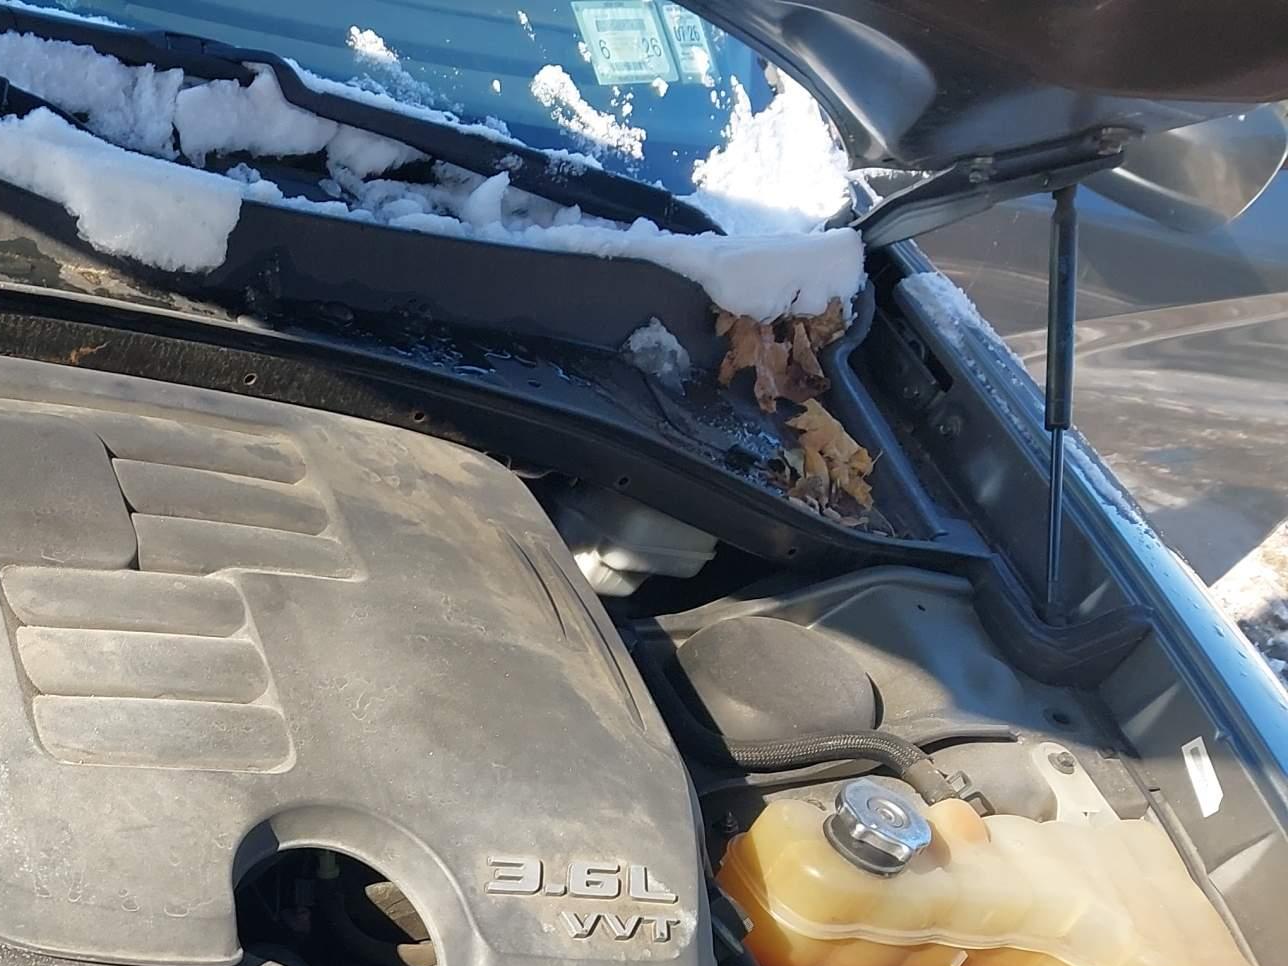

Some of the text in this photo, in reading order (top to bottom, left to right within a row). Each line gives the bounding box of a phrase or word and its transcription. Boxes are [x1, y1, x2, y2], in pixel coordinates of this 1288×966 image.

[598, 37, 662, 60] 6 26
[485, 855, 679, 905] 3.6L
[561, 911, 681, 943] VVT
